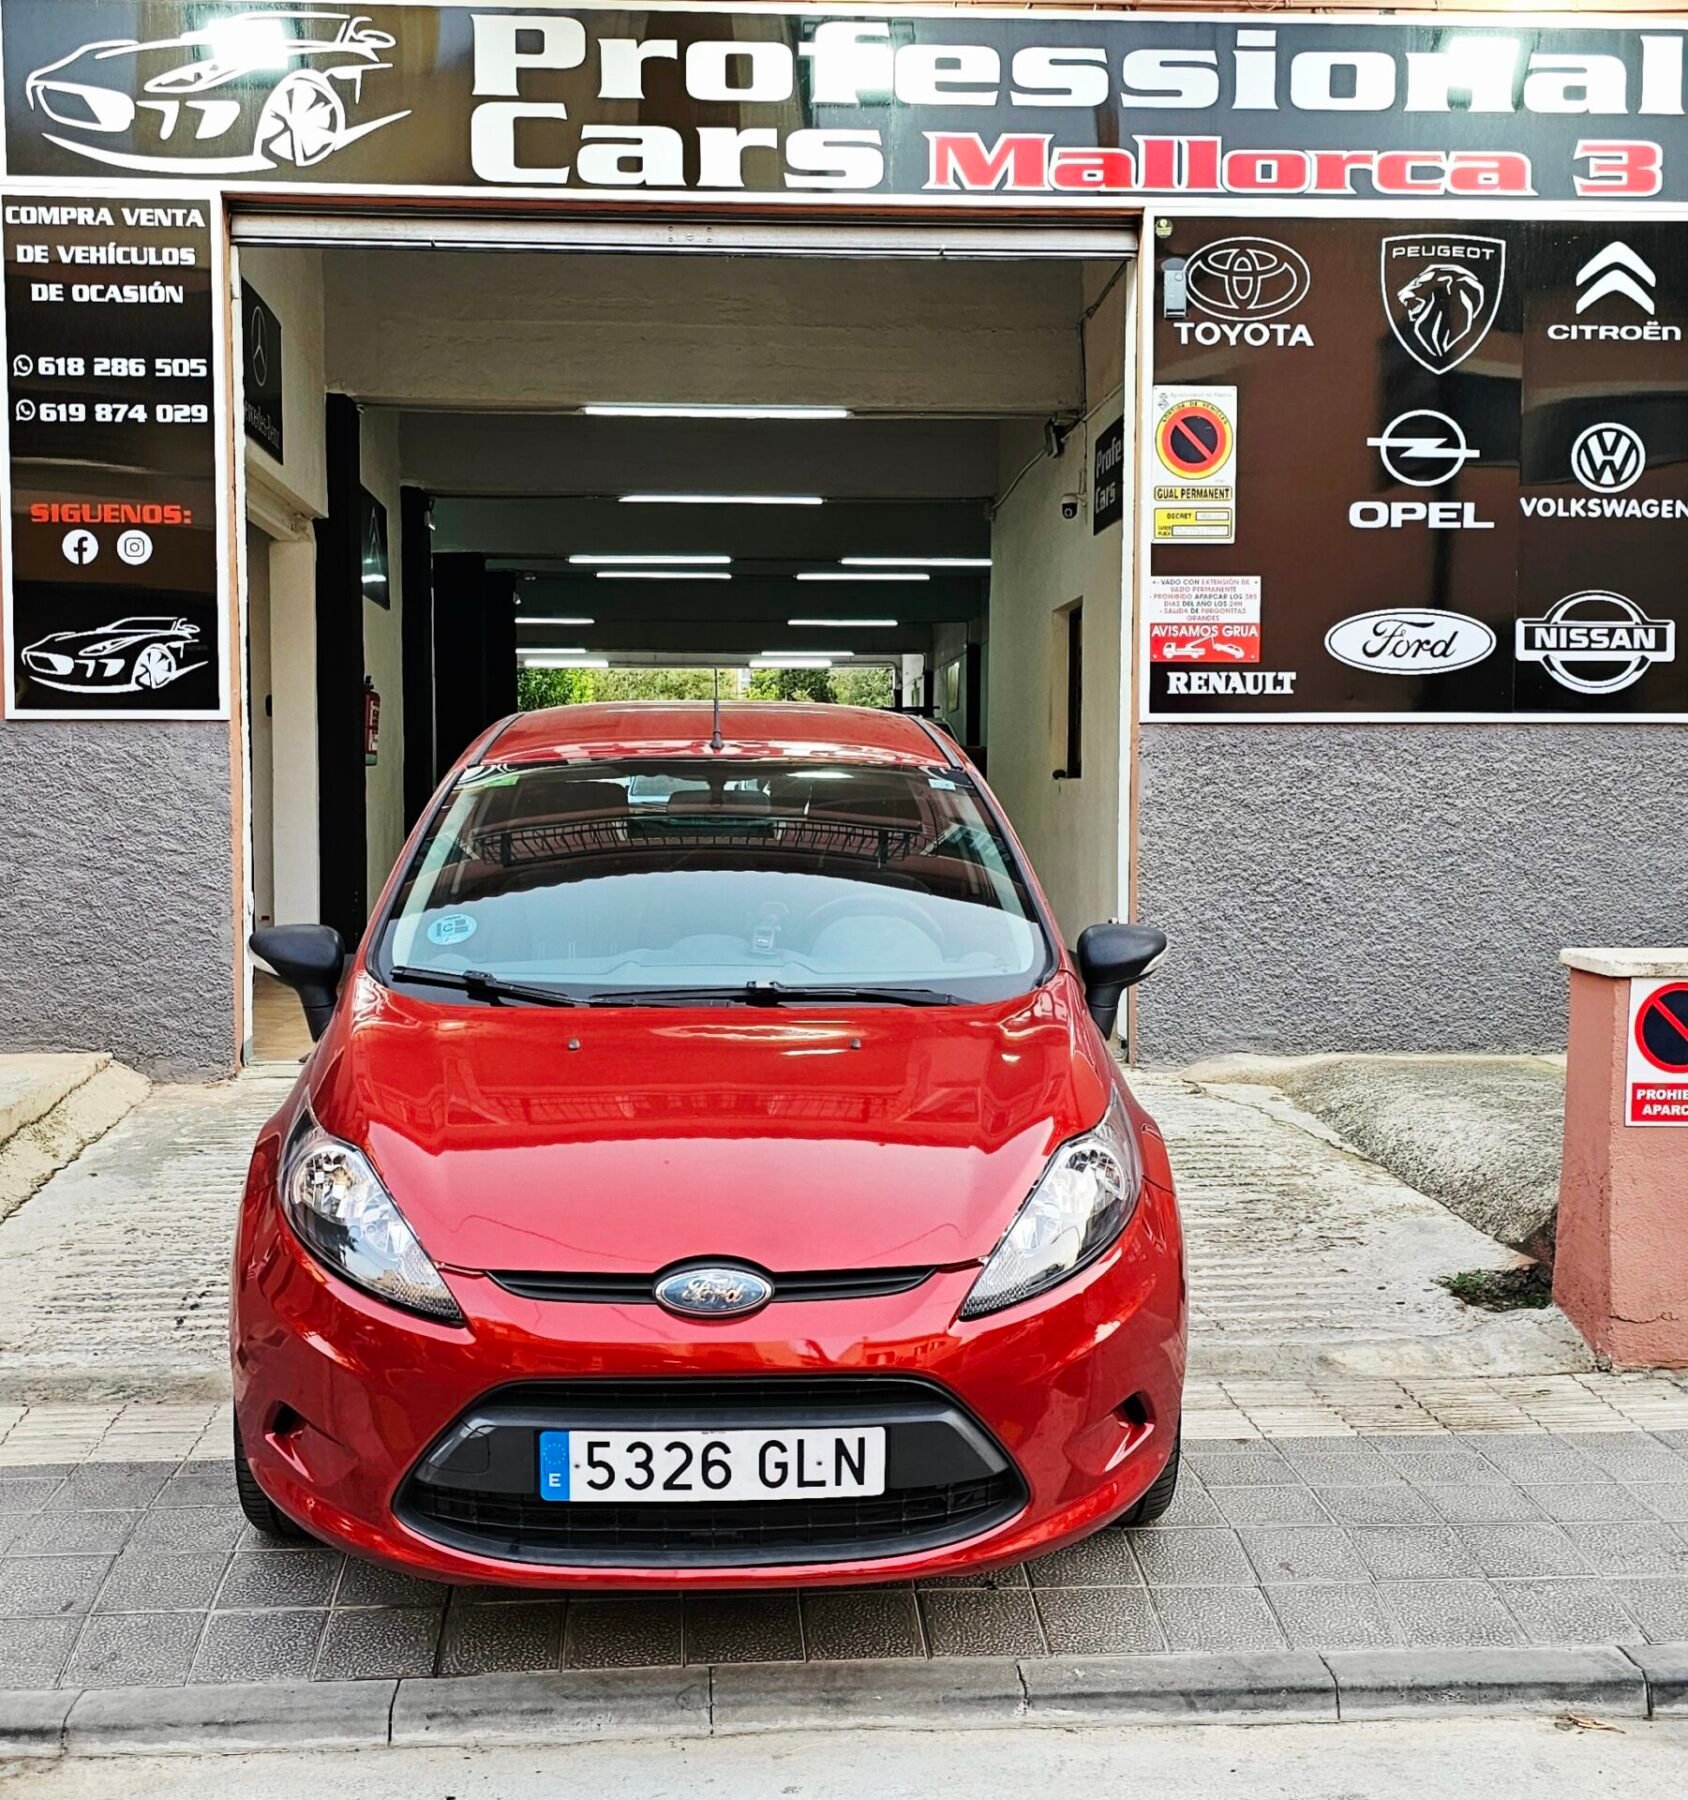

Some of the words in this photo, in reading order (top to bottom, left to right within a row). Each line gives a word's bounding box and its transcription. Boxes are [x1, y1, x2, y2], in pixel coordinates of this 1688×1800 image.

[470, 14, 1686, 116] Professional
[470, 101, 884, 187] Cars
[924, 132, 1540, 197] Mallorca
[1574, 139, 1664, 197] 3
[5, 206, 114, 226] COMPRA
[121, 208, 206, 228] VENTA
[16, 245, 49, 264] DE
[56, 243, 196, 266] VEHÍCULOS
[1391, 246, 1495, 260] PEUGEOT
[31, 284, 64, 302] DE
[72, 282, 184, 304] OCASIÓN
[1173, 322, 1315, 347] TOYOTA
[38, 357, 85, 377] 618
[93, 358, 146, 377] 286
[155, 358, 207, 377] 505
[39, 403, 86, 423] 619
[94, 404, 147, 423] 874
[156, 404, 208, 423] 029
[1095, 481, 1116, 515] Cars
[1157, 488, 1179, 499] GUAL
[1180, 488, 1230, 499] PERMANENT
[30, 503, 192, 525] SIGUENOS:
[1166, 512, 1192, 520] DECRET
[1349, 501, 1495, 529] OPEL
[1520, 496, 1688, 519] VOLKSWAGEN
[1160, 578, 1182, 586] VADO
[1163, 607, 1188, 615] SALIDA
[1190, 607, 1199, 615] DE
[1182, 600, 1194, 608] DEL
[1214, 600, 1228, 608] LOS
[1151, 624, 1219, 638] AVISAMOS
[1222, 625, 1258, 638] GRUA
[1362, 619, 1458, 659] Ford
[1534, 628, 1656, 650] NISSAN
[1166, 671, 1296, 695] RENAULT
[1641, 1104, 1688, 1116] APARC
[681, 1276, 743, 1304] Ford
[586, 1441, 732, 1491] 5326
[758, 1436, 865, 1488] GLN
[548, 1473, 561, 1487] E
